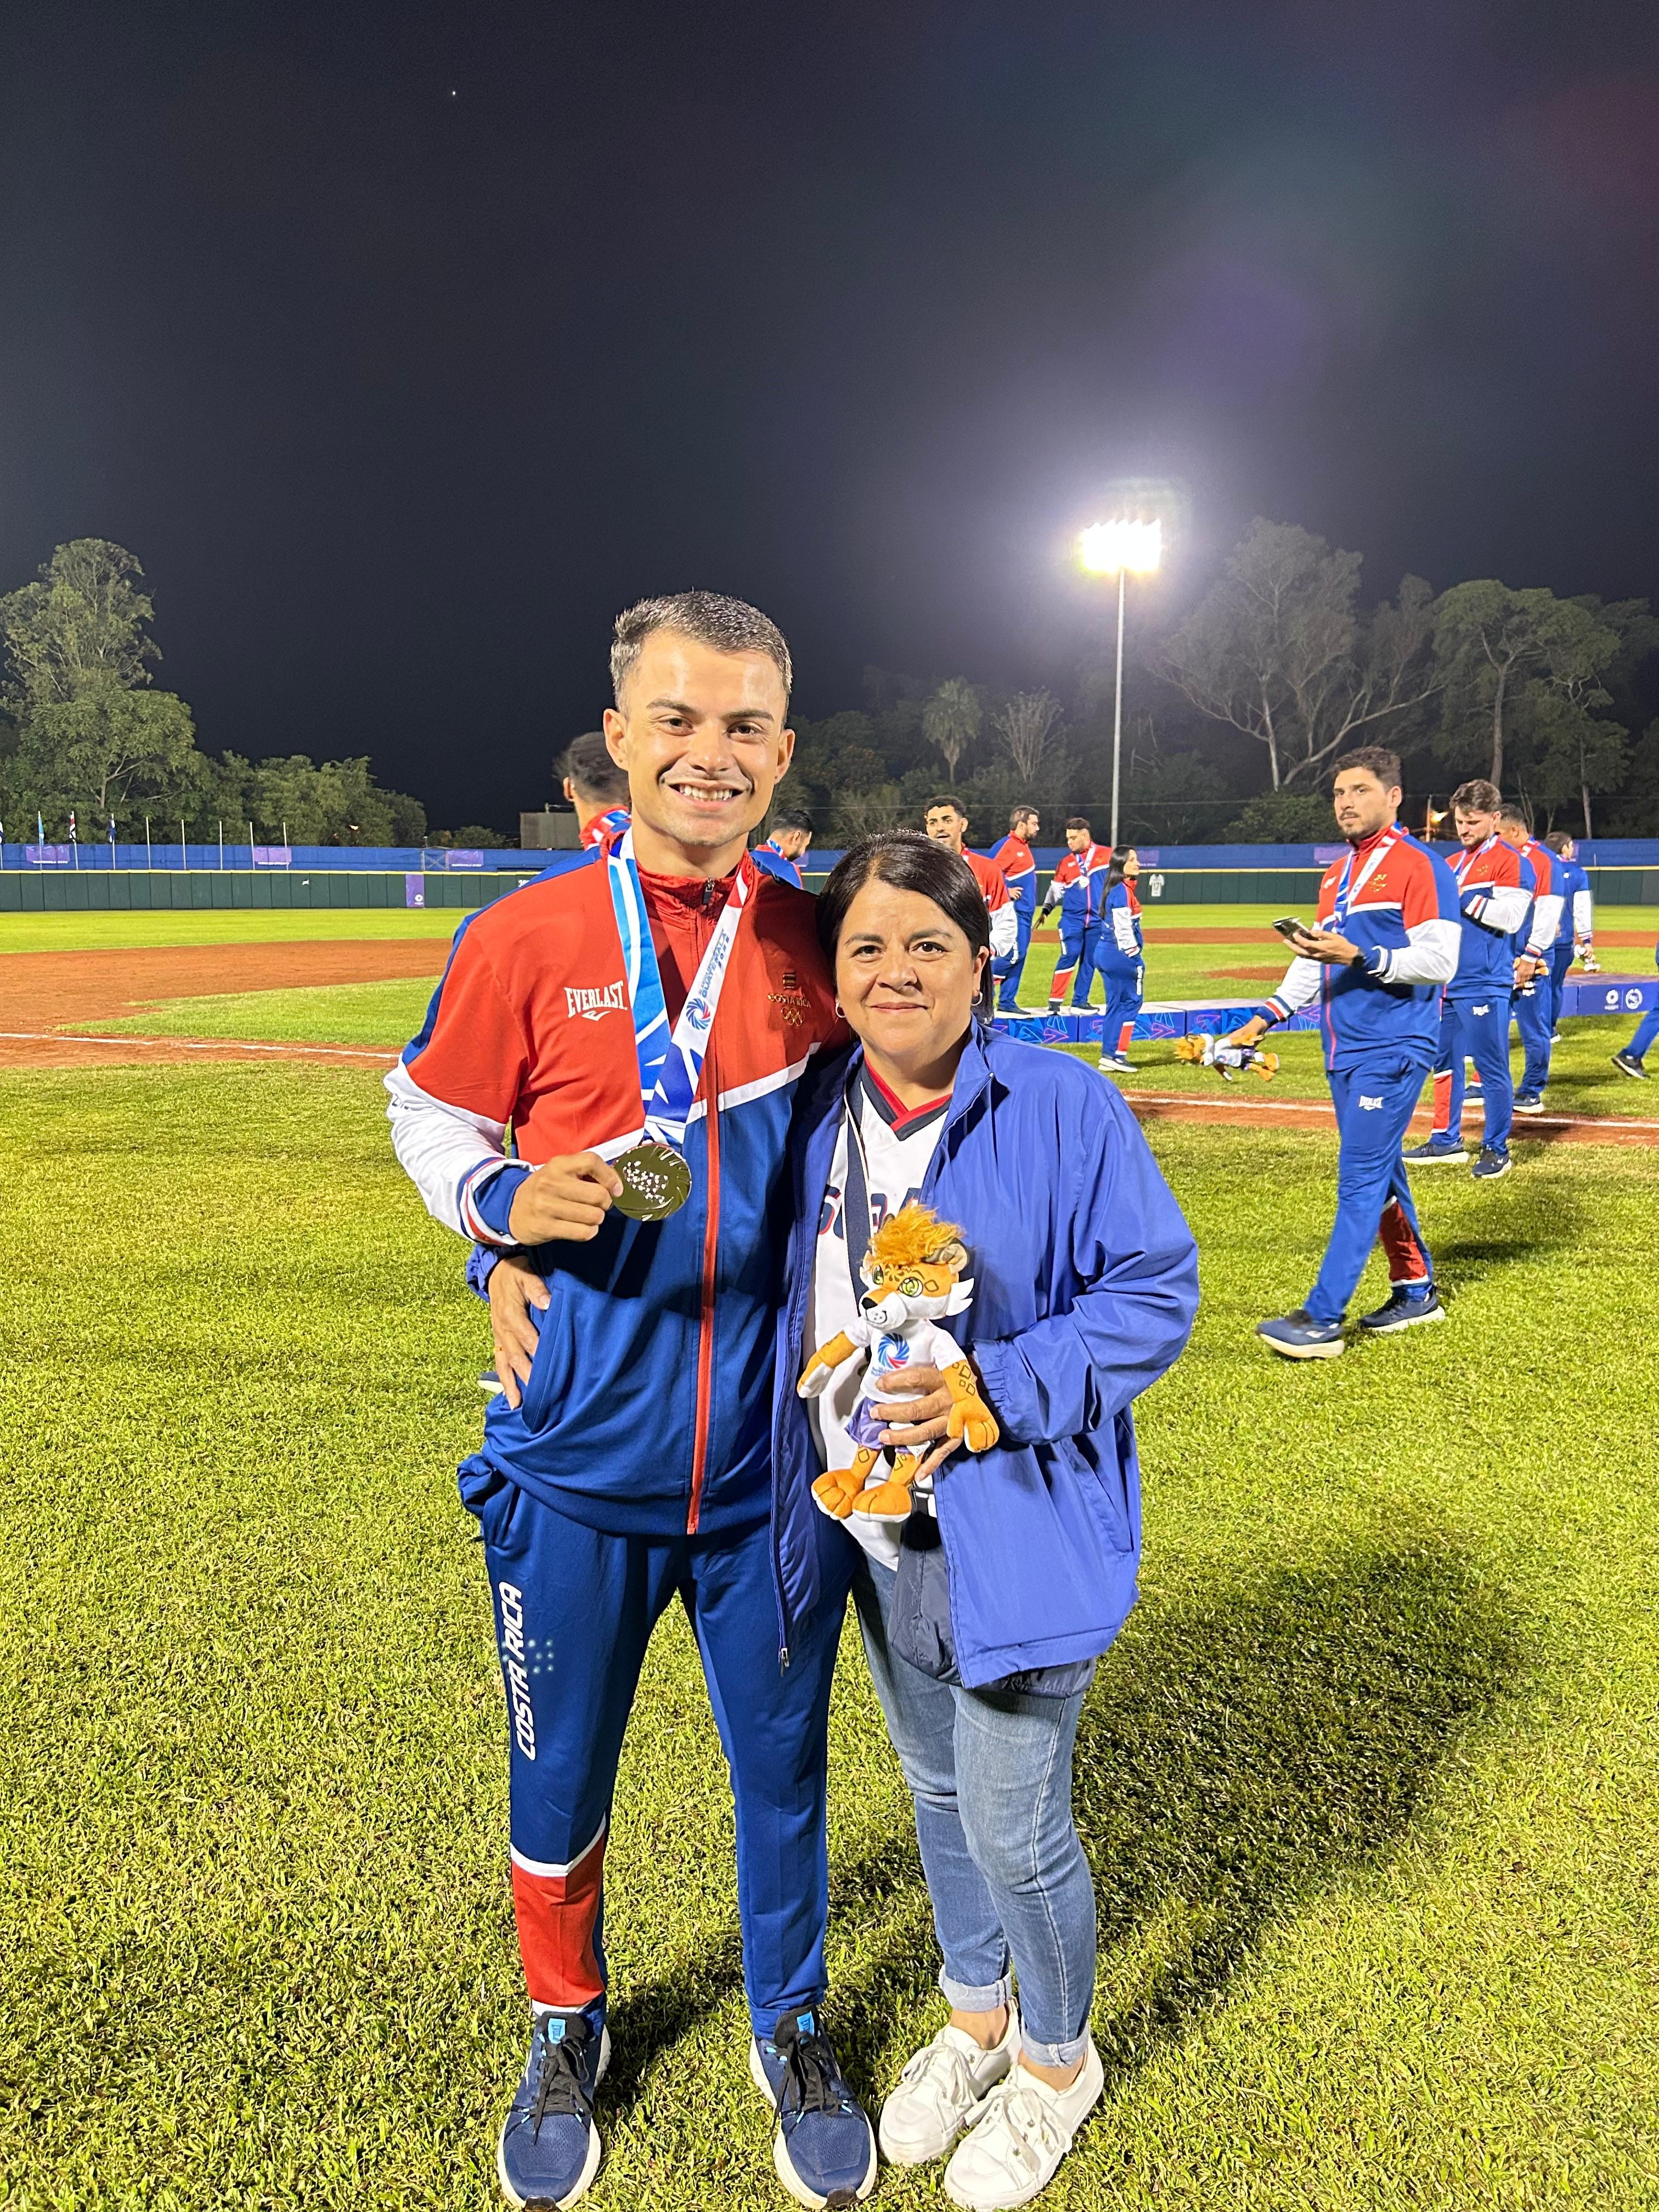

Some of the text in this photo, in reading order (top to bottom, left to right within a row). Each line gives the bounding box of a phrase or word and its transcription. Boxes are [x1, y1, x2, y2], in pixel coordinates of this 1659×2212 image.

[564, 980, 627, 1018] EVERLAST
[767, 992, 811, 1008] COSTA RICA
[499, 1581, 536, 1760] COSTA RICA
